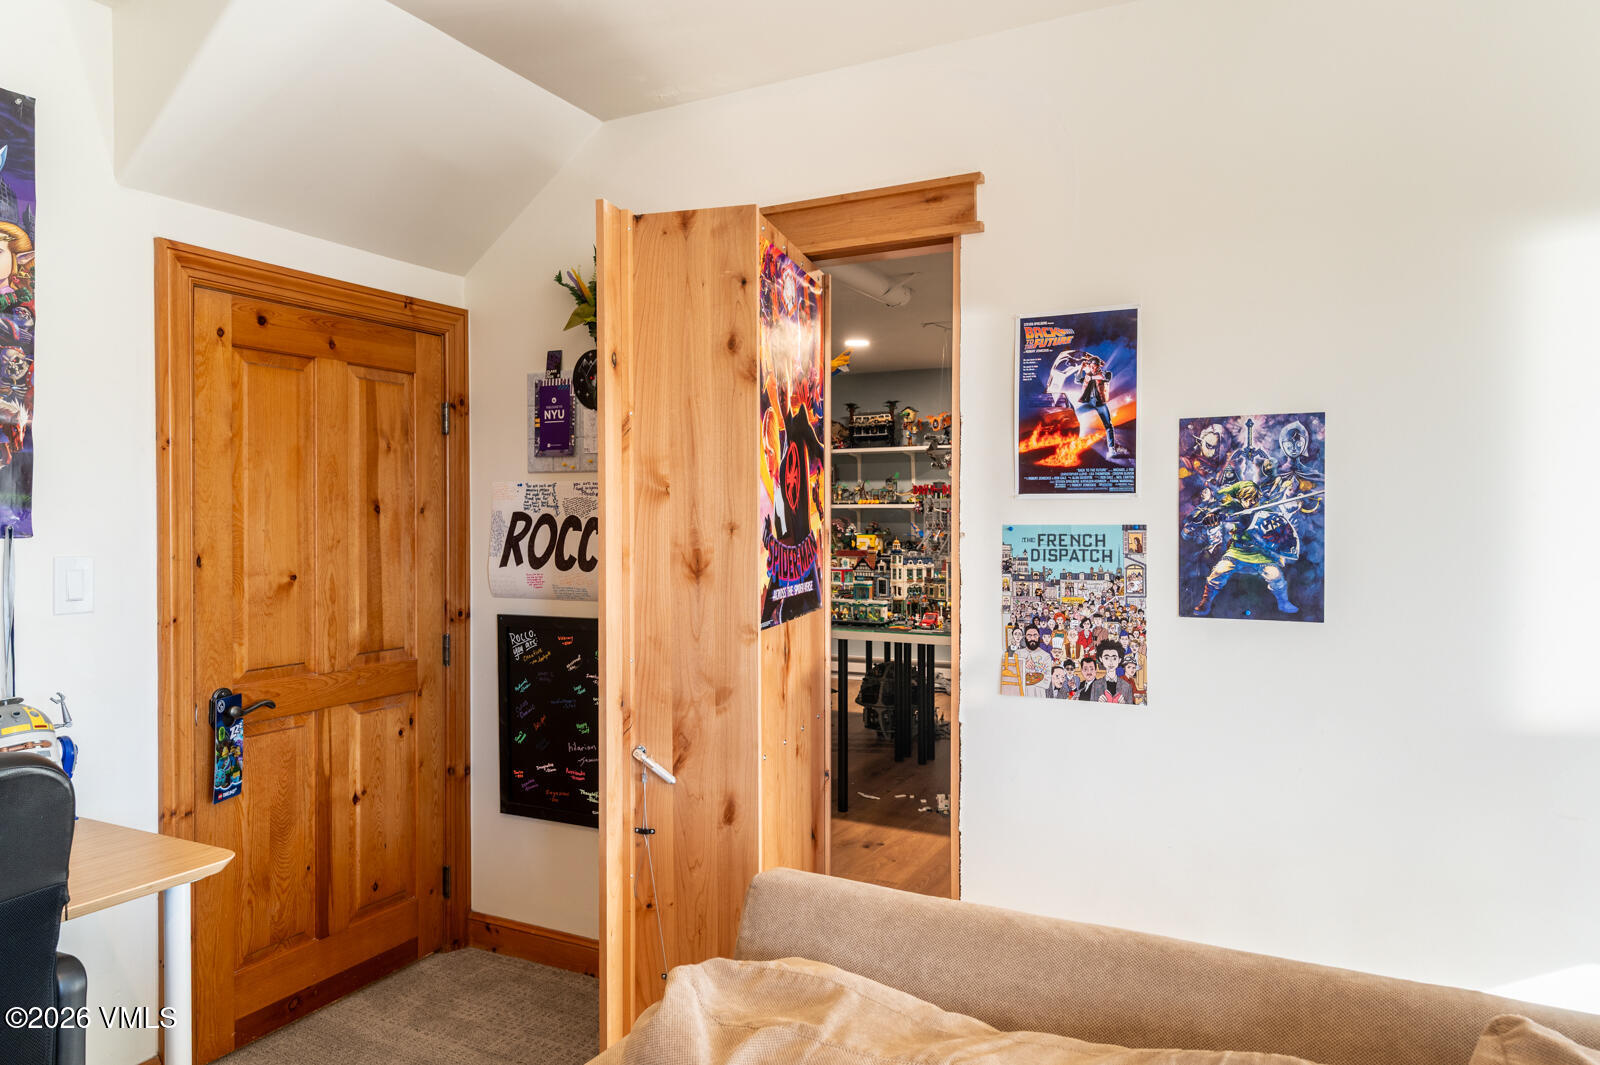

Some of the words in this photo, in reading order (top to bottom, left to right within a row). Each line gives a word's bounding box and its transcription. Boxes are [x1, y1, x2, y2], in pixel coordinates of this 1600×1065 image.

[1024, 327, 1064, 339] BACK
[1033, 336, 1074, 349] FUTURE
[544, 409, 565, 420] NYU
[1037, 533, 1106, 547] FRENCH
[1030, 549, 1113, 563] DISPATCH
